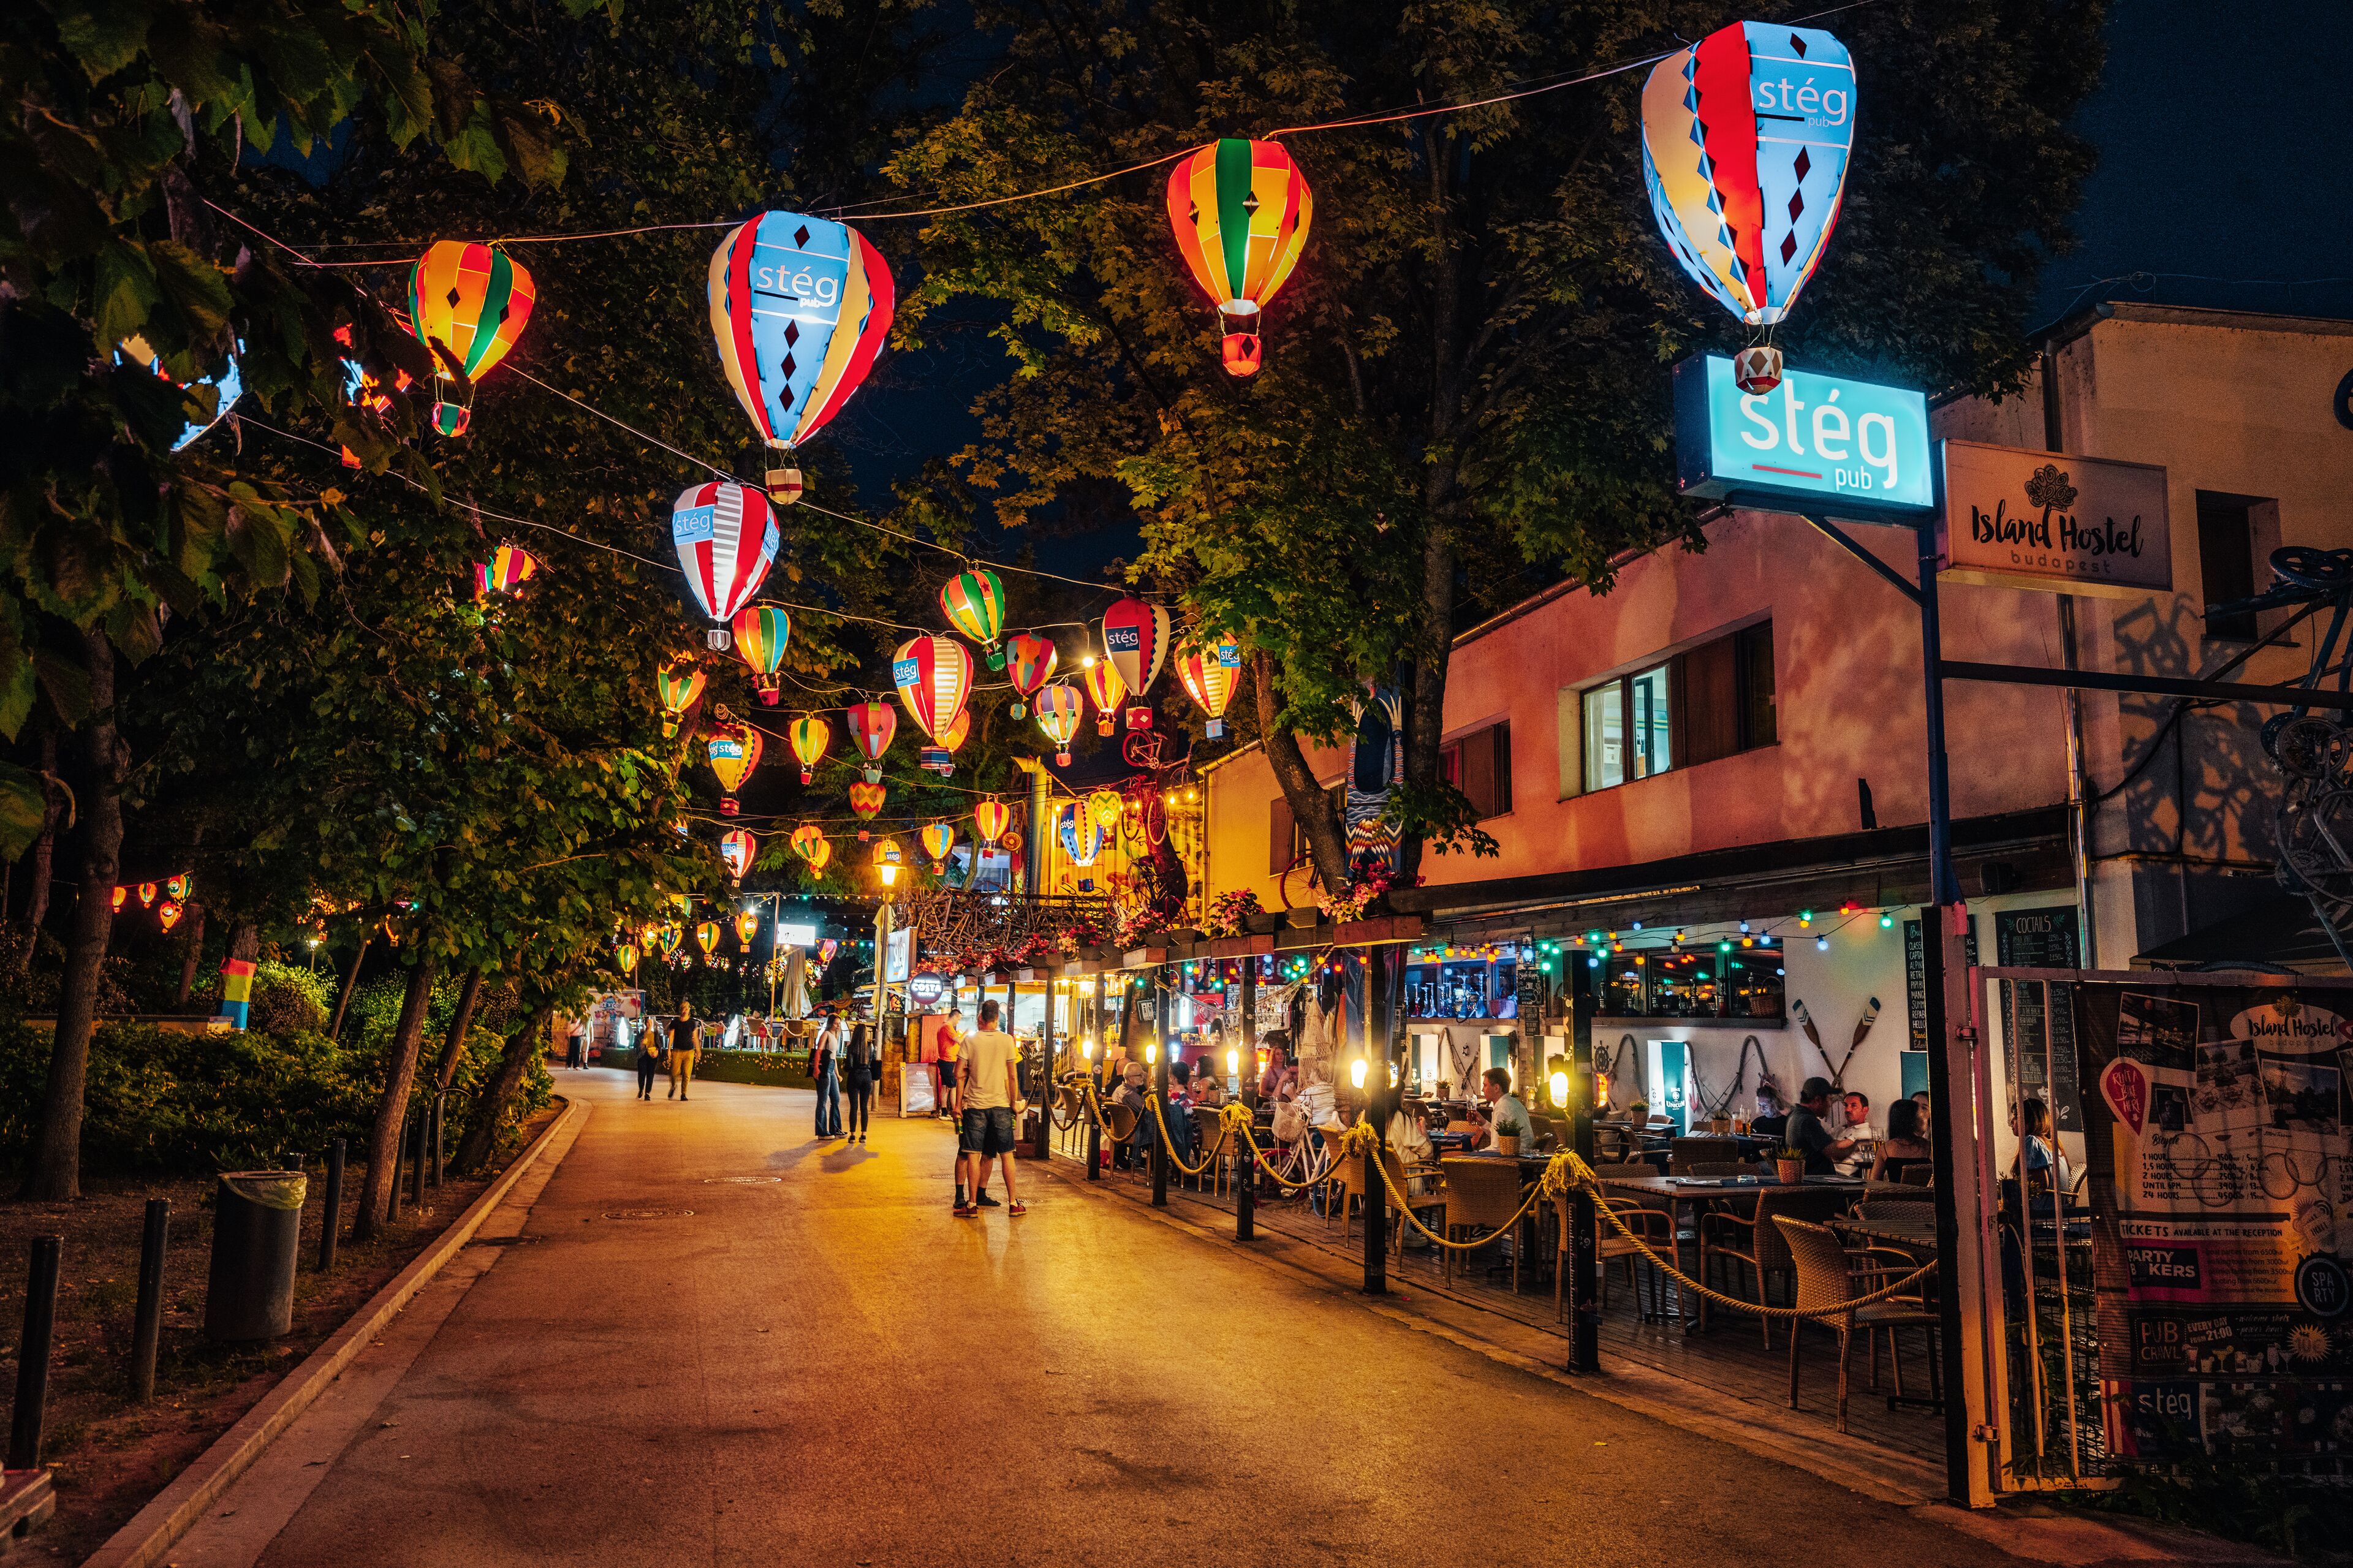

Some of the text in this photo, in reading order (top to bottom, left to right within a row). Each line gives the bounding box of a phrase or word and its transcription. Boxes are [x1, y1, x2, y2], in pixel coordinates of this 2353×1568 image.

[1758, 77, 1847, 126] stég
[1808, 115, 1830, 127] pub
[757, 265, 839, 307] stég
[799, 297, 820, 308] pub
[1740, 377, 1898, 490] stég
[1835, 465, 1873, 492] pub
[675, 512, 710, 533] stég
[1971, 499, 2144, 558] Island Hostel
[2010, 549, 2112, 574] budapest
[1108, 630, 1139, 645] stég
[896, 663, 917, 679] stég
[1061, 819, 1074, 829] stég
[722, 844, 736, 853] stég
[1910, 925, 1922, 938] Bu
[2016, 915, 2052, 933] COCTAILS
[911, 983, 942, 993] COSTA
[2248, 1013, 2336, 1037] Island Hostel
[2133, 1070, 2139, 1083] A
[2142, 1162, 2154, 1171] 1,5
[2151, 1172, 2173, 1181] HOURS
[2158, 1192, 2180, 1200] HOURS
[2121, 1224, 2169, 1237] TICKETS
[2242, 1229, 2283, 1238] RECEPTION
[2127, 1249, 2175, 1263] PARTY
[2311, 1271, 2335, 1287] SPA
[2313, 1287, 2335, 1303] RTY
[2141, 1321, 2180, 1344] PUB
[2186, 1319, 2213, 1334] EVERY
[2205, 1325, 2234, 1342] 21:00
[2141, 1346, 2181, 1361] CRAWL
